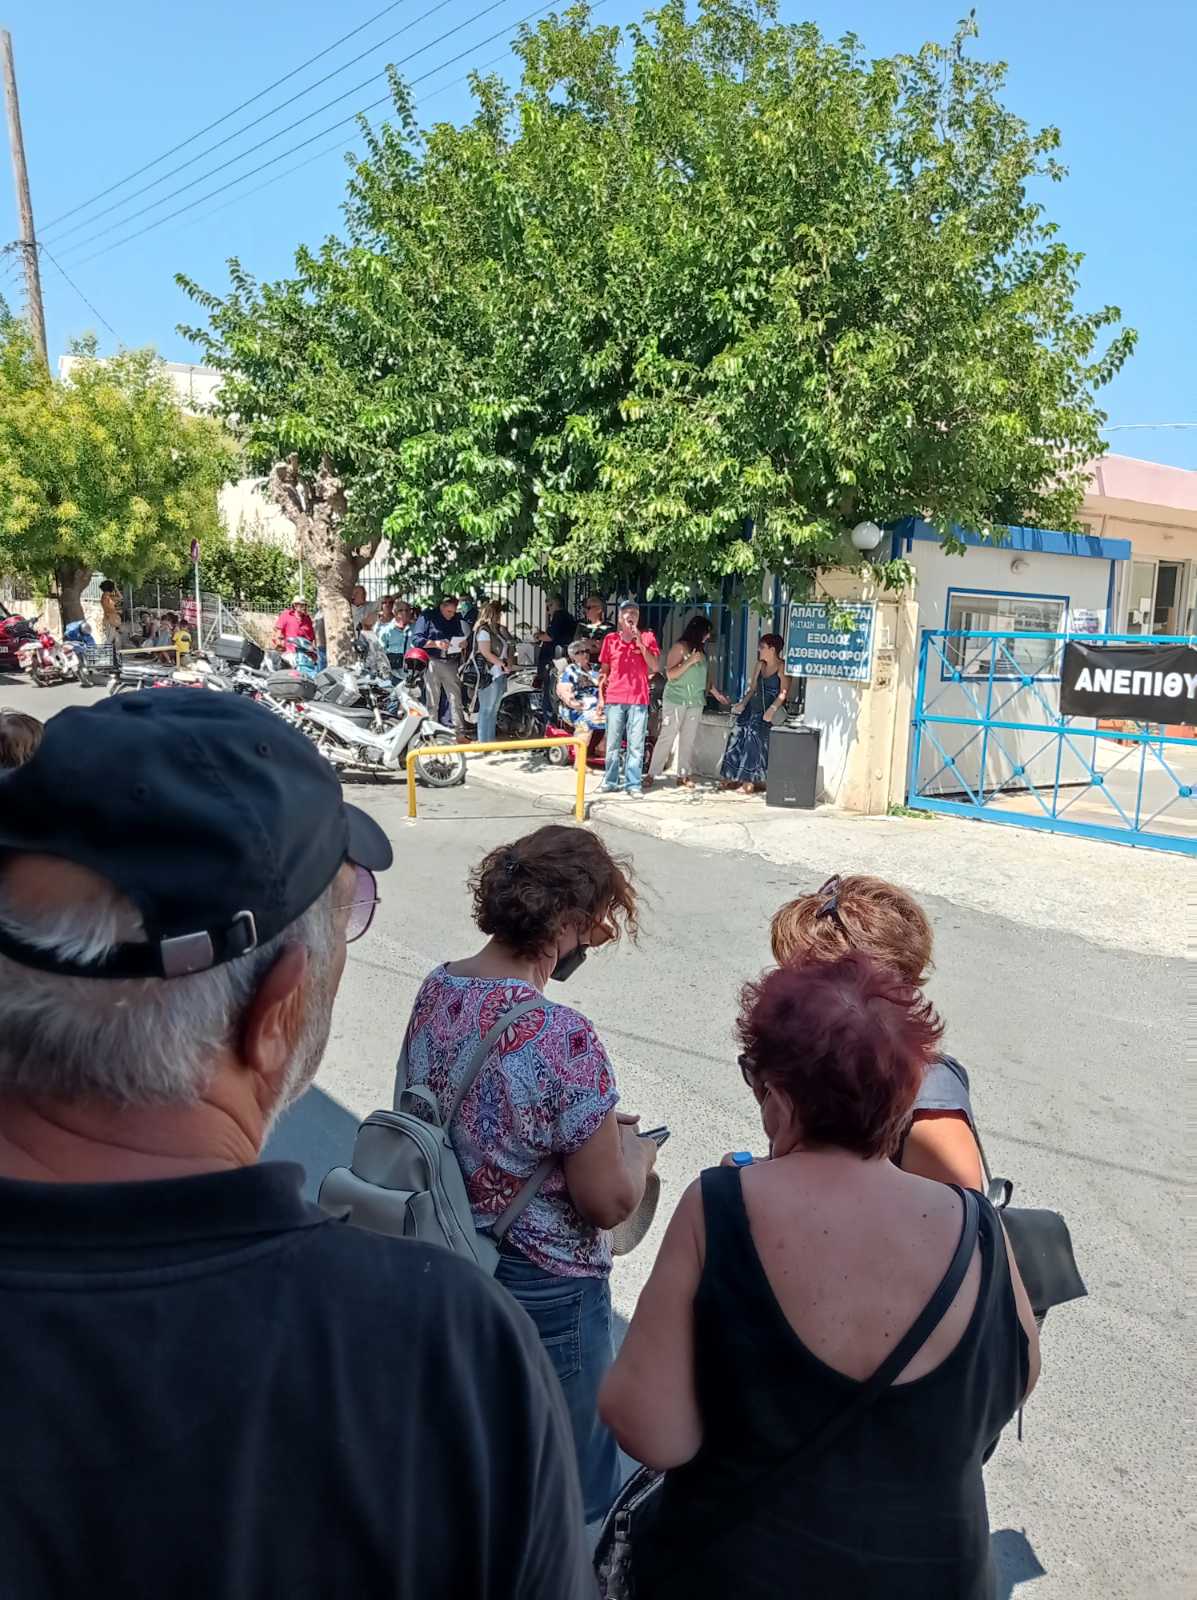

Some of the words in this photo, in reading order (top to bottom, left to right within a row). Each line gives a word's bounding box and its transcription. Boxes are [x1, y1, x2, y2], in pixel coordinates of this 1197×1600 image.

[791, 607, 871, 620] ΑΠΑΓΟΤΑΙ
[807, 633, 851, 645] ΕΞΟΔΟΣ
[788, 647, 869, 663] ΑΣΘΕΝΟΦΟΡΟΥ
[805, 662, 867, 678] ΟΧΗΜΑΤΩΝ
[1074, 667, 1197, 699] ΑΝΕΠΙΘΥ
